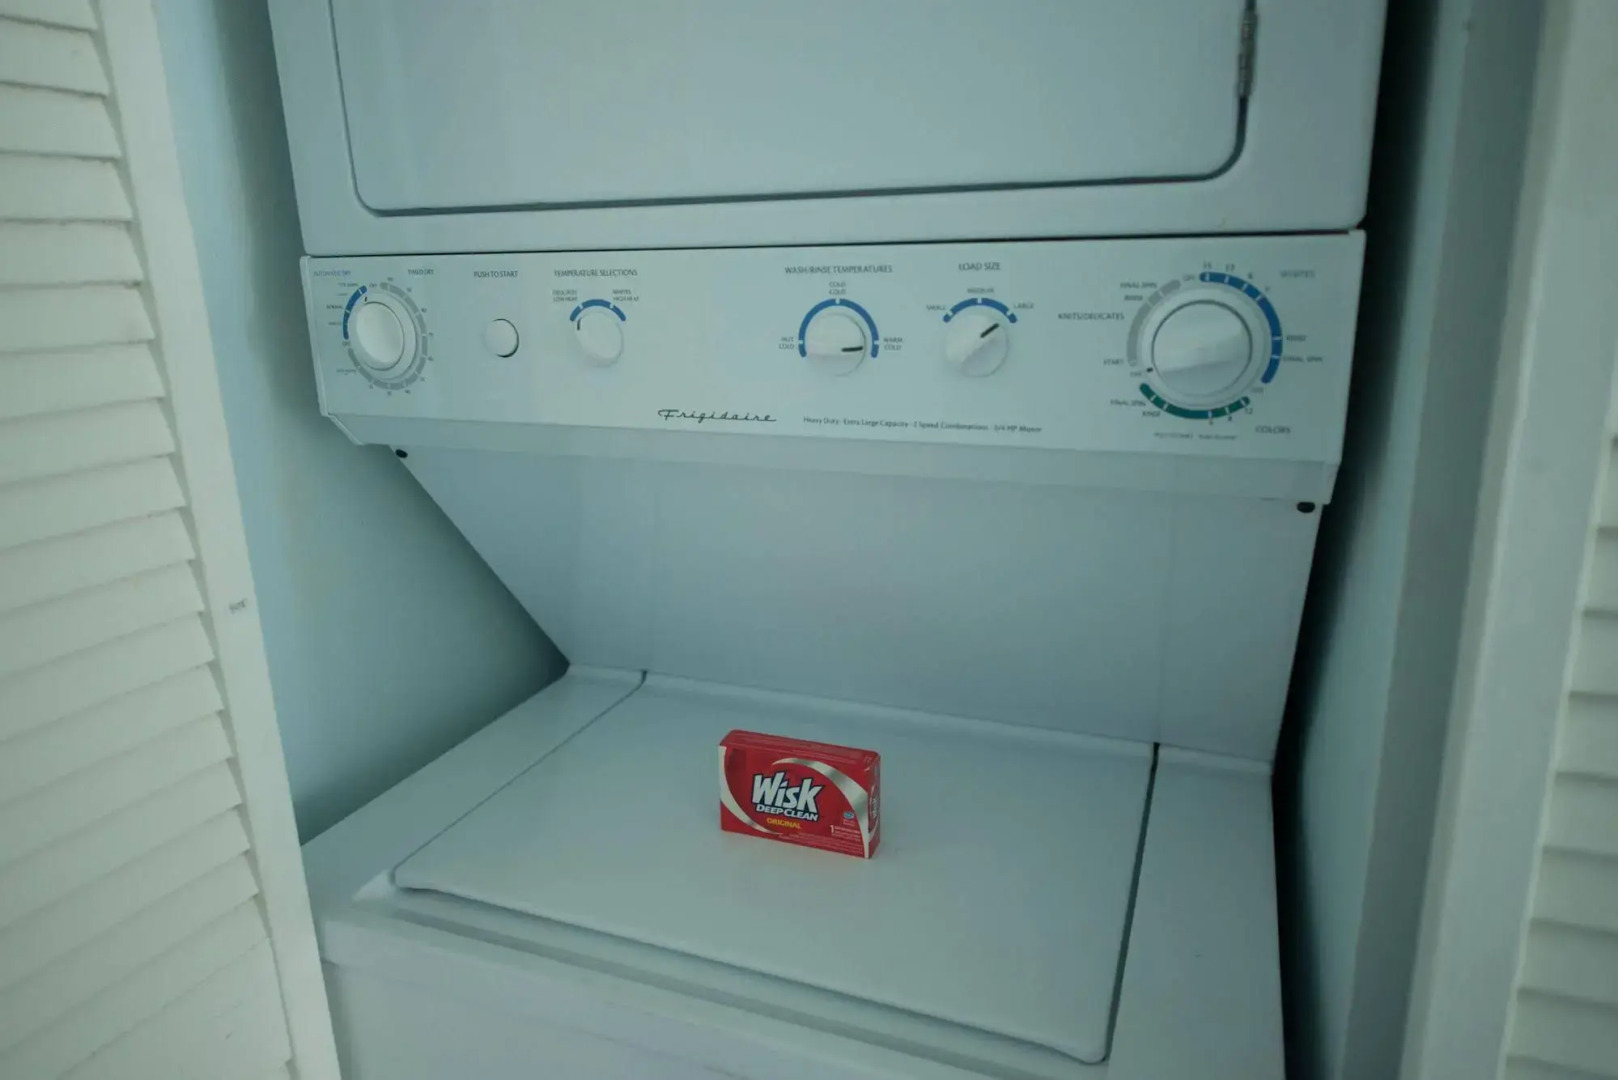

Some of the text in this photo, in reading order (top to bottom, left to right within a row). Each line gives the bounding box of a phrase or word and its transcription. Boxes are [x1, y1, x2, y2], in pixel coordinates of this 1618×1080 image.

[833, 265, 893, 273] TEMPERATURES
[959, 262, 1001, 271] LOAD SIZE
[500, 270, 518, 278] START
[598, 269, 638, 277] SELECTIONS
[657, 408, 777, 424] Frigidaire
[803, 416, 822, 424] Heavy
[752, 771, 823, 813] Wisk
[756, 804, 819, 821] DEEP CLEAN
[766, 817, 802, 829] ORIGINAL
